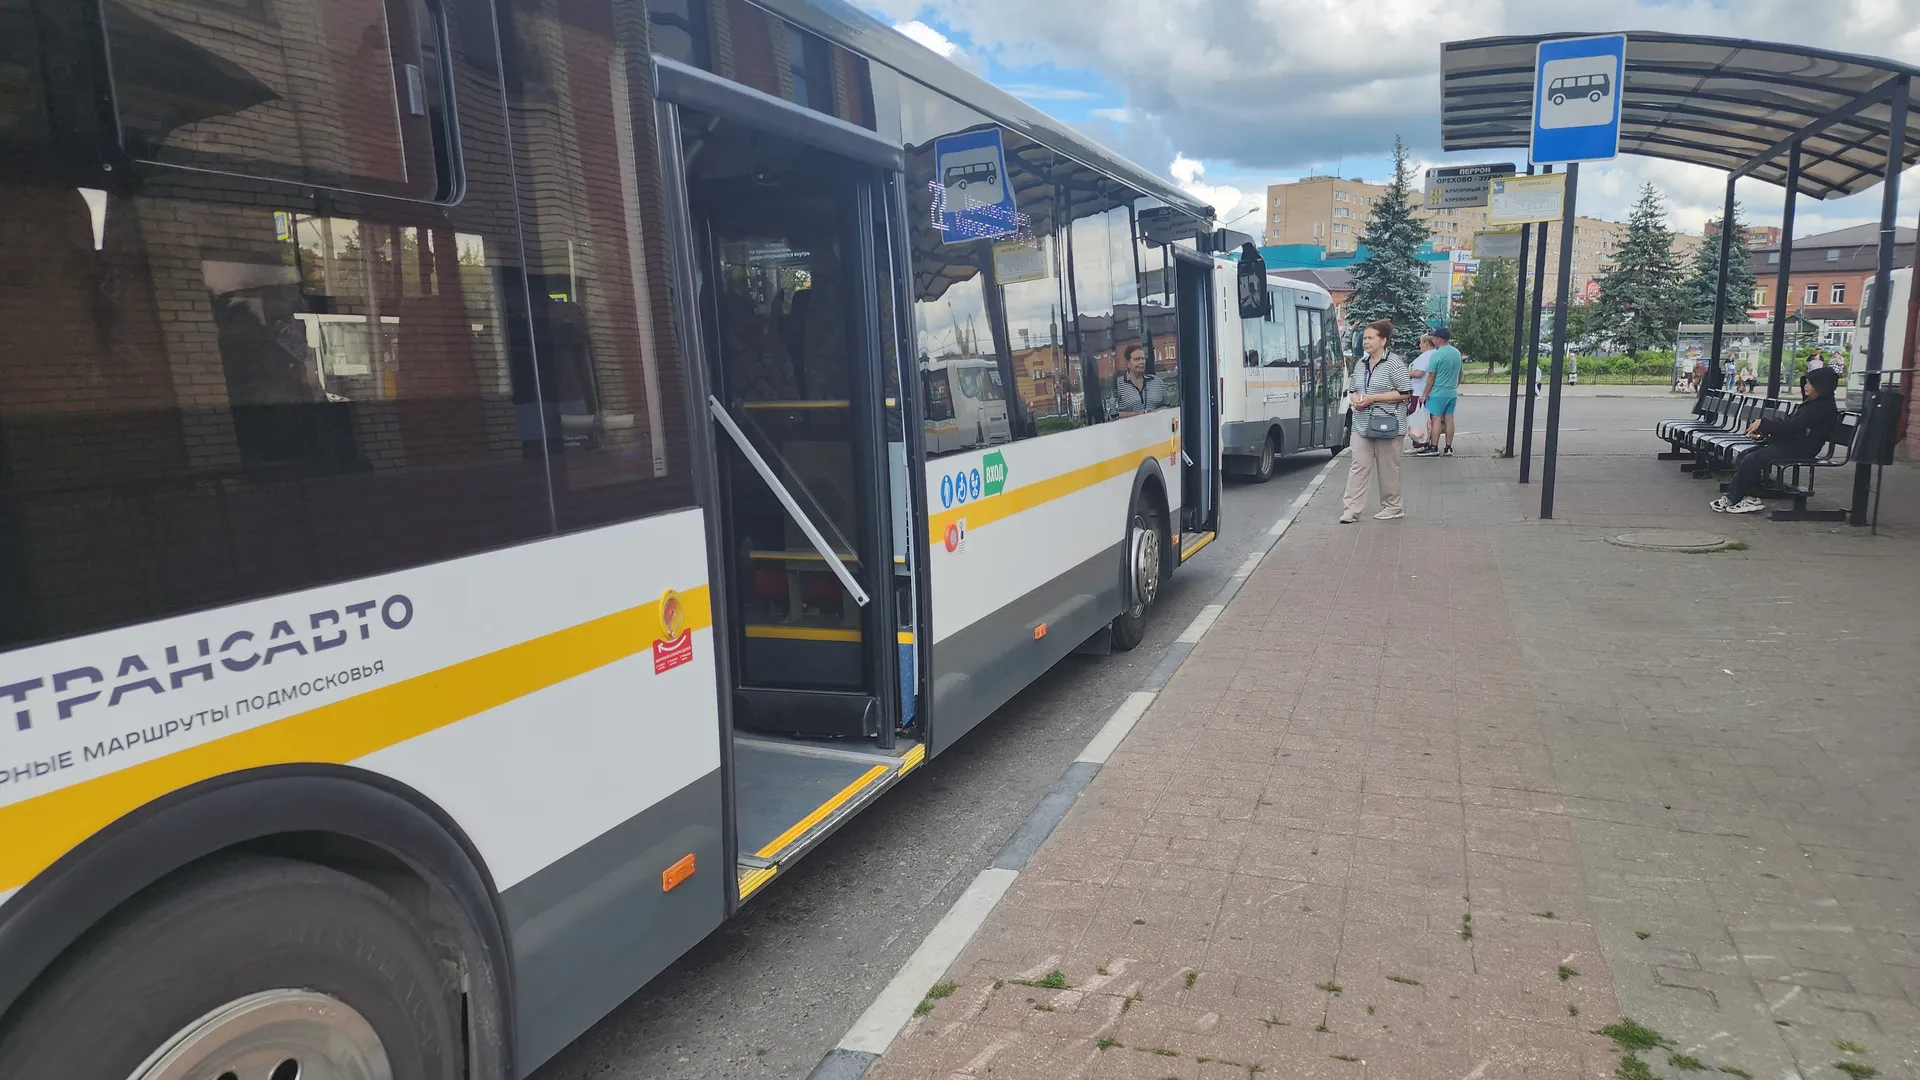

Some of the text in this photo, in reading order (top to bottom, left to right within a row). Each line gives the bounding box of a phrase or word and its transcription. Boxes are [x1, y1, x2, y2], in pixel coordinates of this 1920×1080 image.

[1431, 167, 1491, 178] 2 ПЕРРОН
[1436, 176, 1473, 184] ОРЕХОВО
[986, 464, 1004, 483] ВХОД
[0, 594, 414, 731] ТРАНСАВТО
[83, 705, 230, 762] МАРШРУТЫ
[235, 660, 385, 715] ПОДМОСКОВЬЯ
